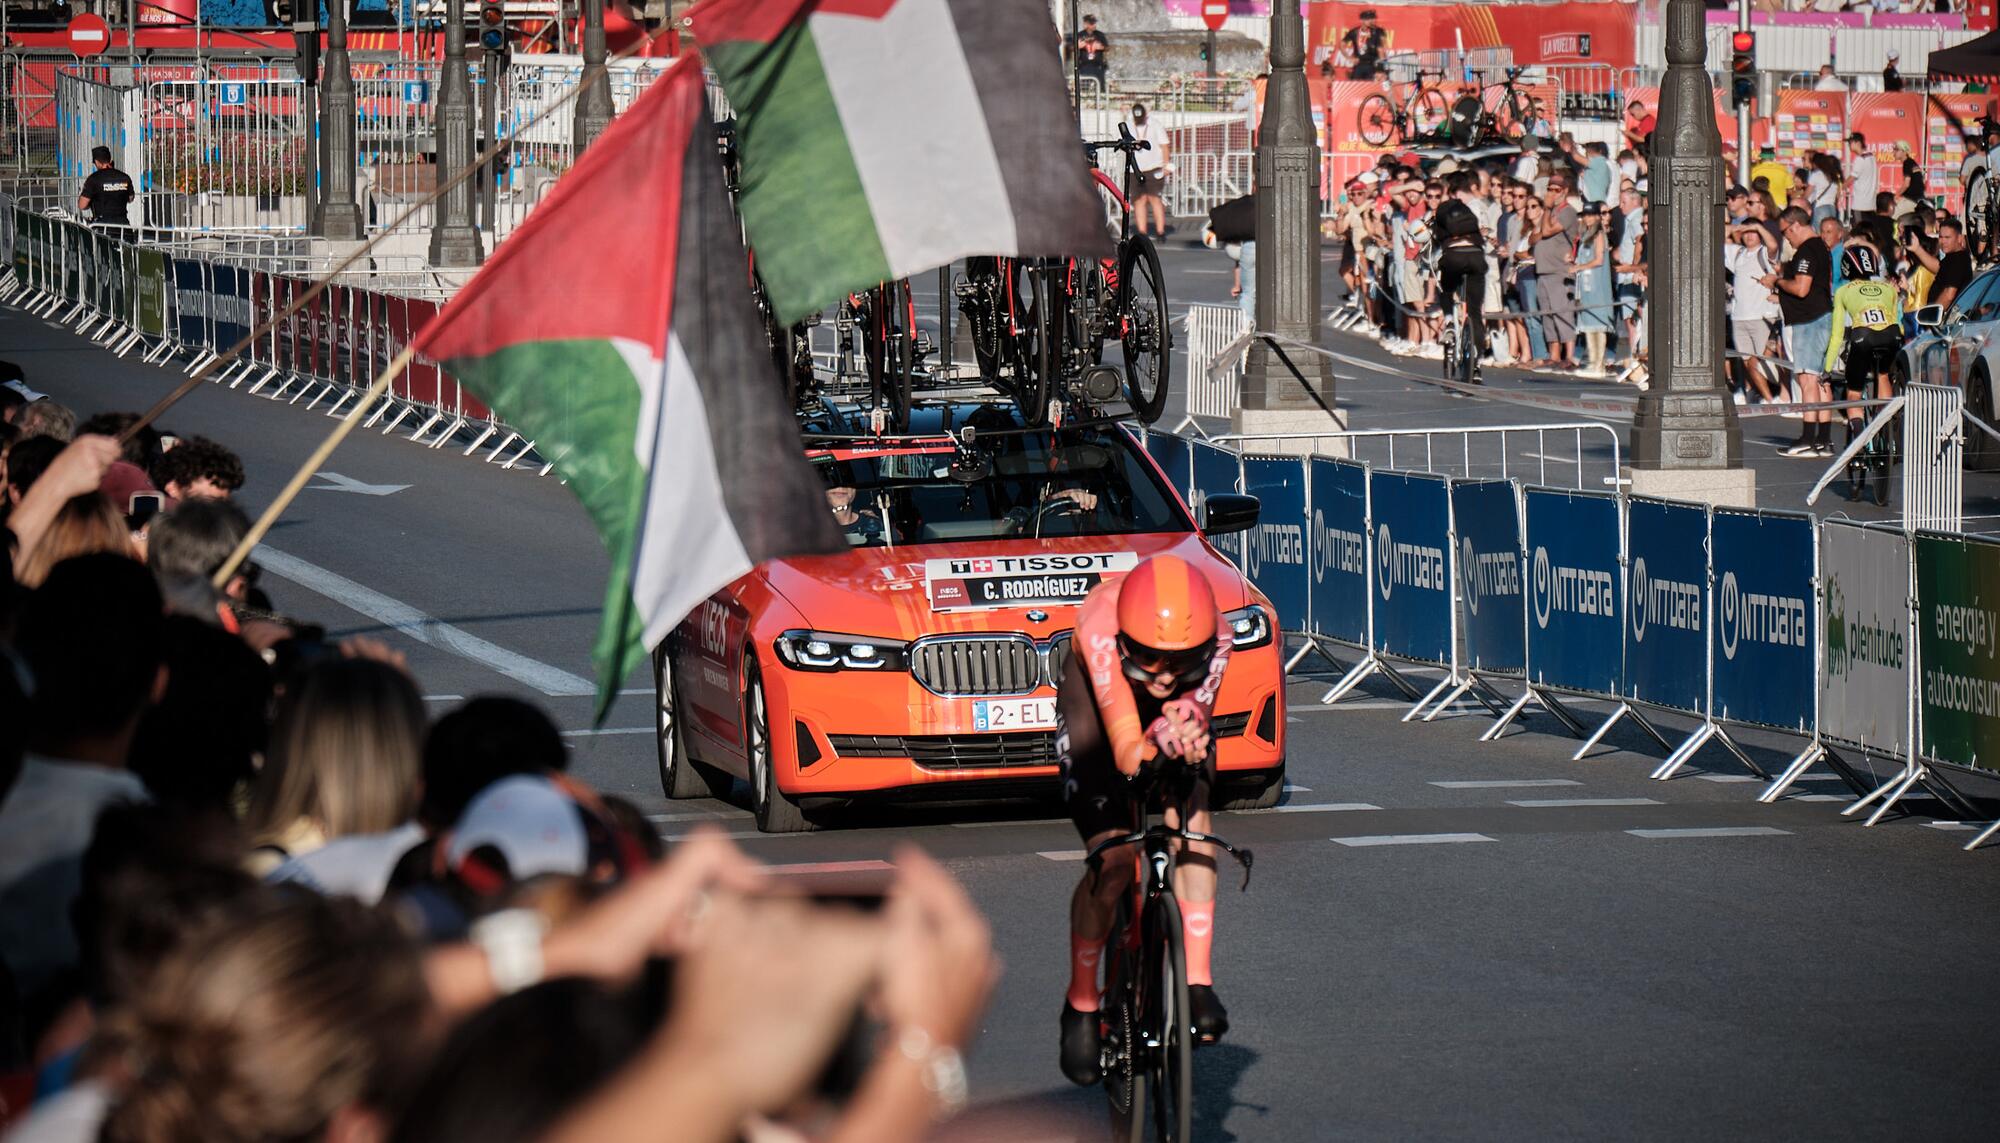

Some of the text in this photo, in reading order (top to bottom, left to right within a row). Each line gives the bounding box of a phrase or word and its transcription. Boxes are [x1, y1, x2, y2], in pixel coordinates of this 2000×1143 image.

[1543, 36, 1590, 57] LA VUELTA 24
[1865, 309, 1886, 324] 151
[996, 553, 1114, 573] TISSOT
[983, 582, 1000, 600] C.
[1003, 574, 1090, 599] RODRÍGUEZ
[701, 600, 730, 657] INEOS
[1850, 610, 1903, 670] plenitude
[1936, 595, 1997, 659] energía y
[1090, 633, 1118, 708] INEOS
[1195, 633, 1232, 706] INEOS
[977, 718, 986, 728] B
